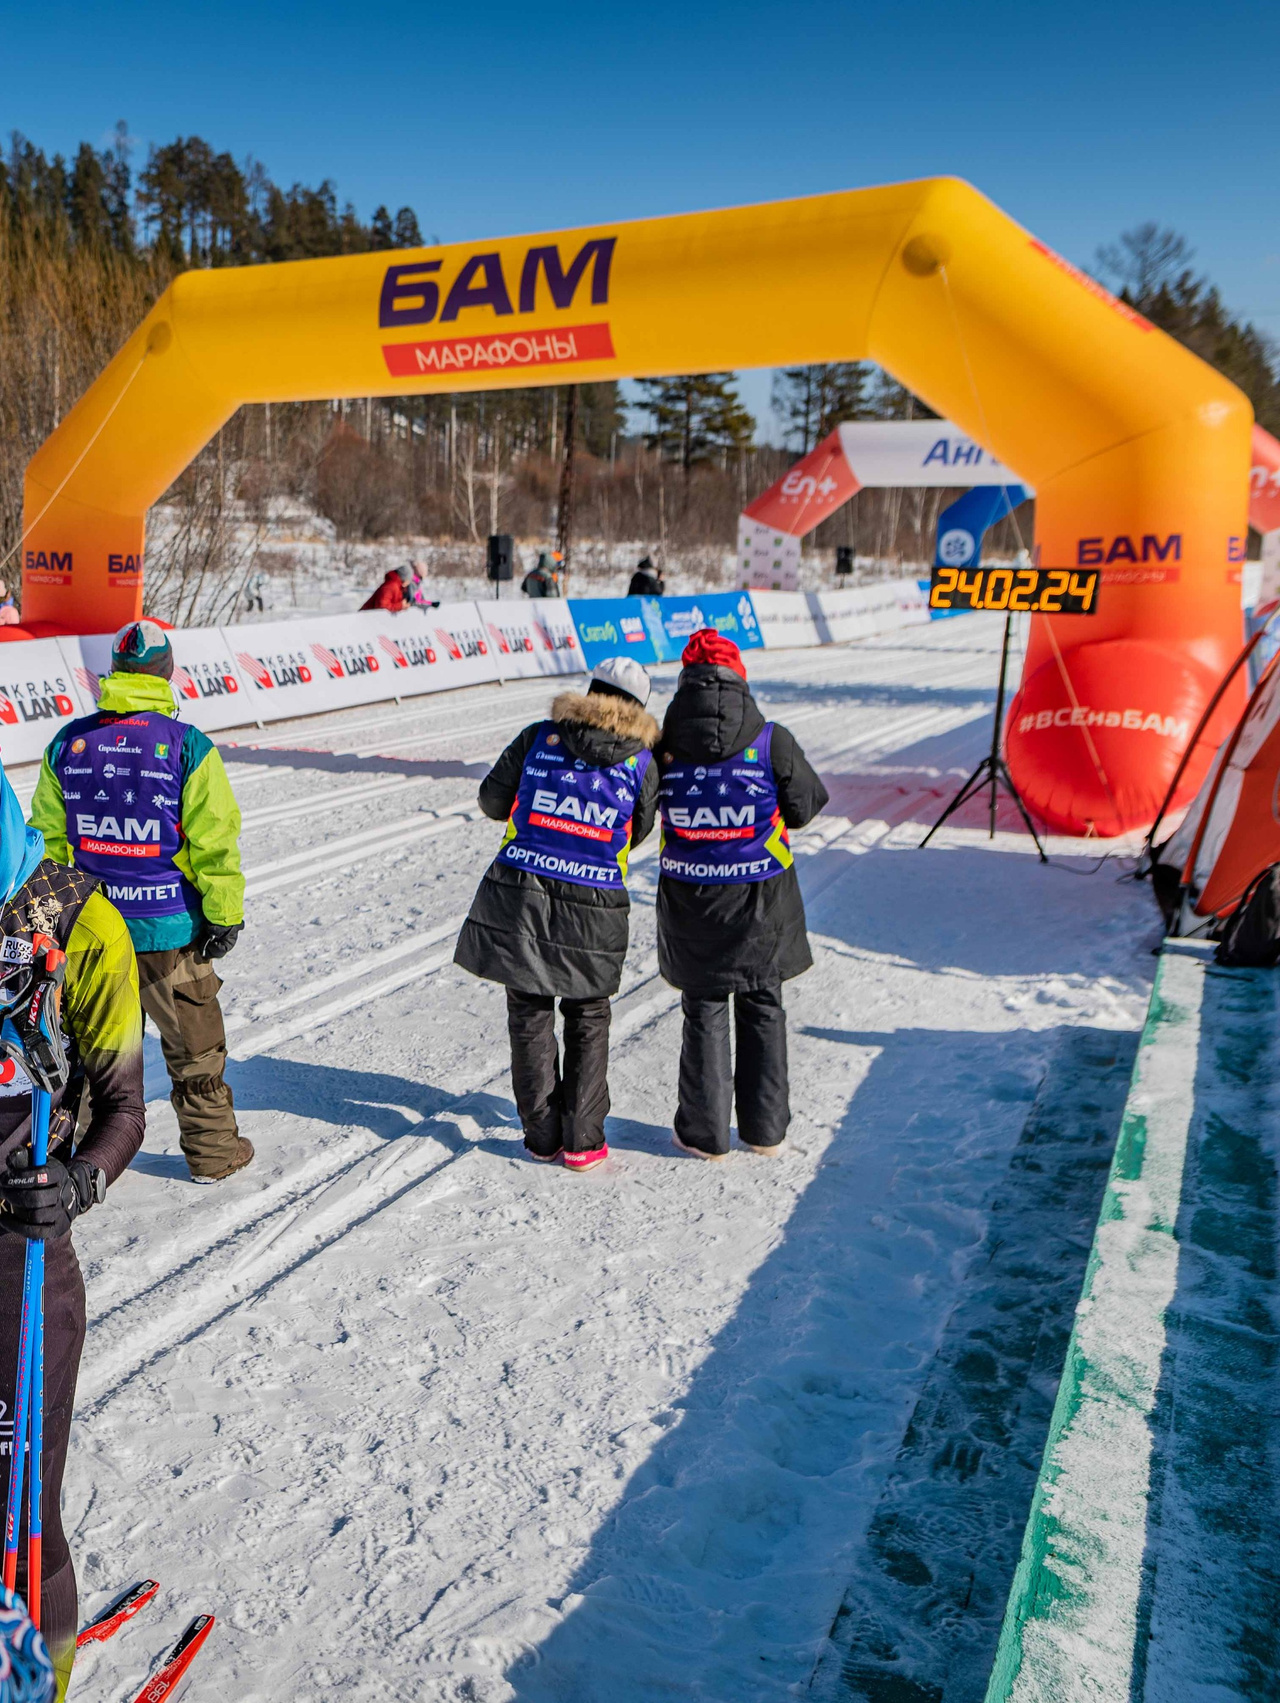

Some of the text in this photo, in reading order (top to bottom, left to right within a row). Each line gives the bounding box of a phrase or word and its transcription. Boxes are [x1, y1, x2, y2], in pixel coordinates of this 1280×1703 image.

[378, 236, 618, 329] БАМ
[415, 332, 578, 372] МАРАФОНЫ
[26, 551, 73, 572] БАМ
[1077, 534, 1182, 566] БАМ
[929, 568, 1097, 611] 24.02.24
[268, 652, 307, 669] KRAS
[337, 642, 374, 659] KRAS
[406, 648, 437, 666] LAND
[192, 661, 232, 678] KRAS
[273, 665, 312, 688] LAND
[344, 655, 380, 676] LAND
[10, 678, 67, 699] KRAS
[197, 675, 238, 698] LAND
[18, 694, 74, 723] LAND
[1020, 706, 1189, 741] #ВСЕнаБАМ
[532, 789, 618, 829] БАМ
[668, 805, 755, 829] БАМ
[76, 814, 160, 841] БАМ
[540, 817, 601, 839] МАРАФОНЫ
[87, 841, 146, 856] МАРАФОНЫ
[506, 845, 618, 883] ОРГКОМИТЕТ
[662, 857, 771, 878] ОРГКОМИТЕТ
[147, 1680, 171, 1703] 198
